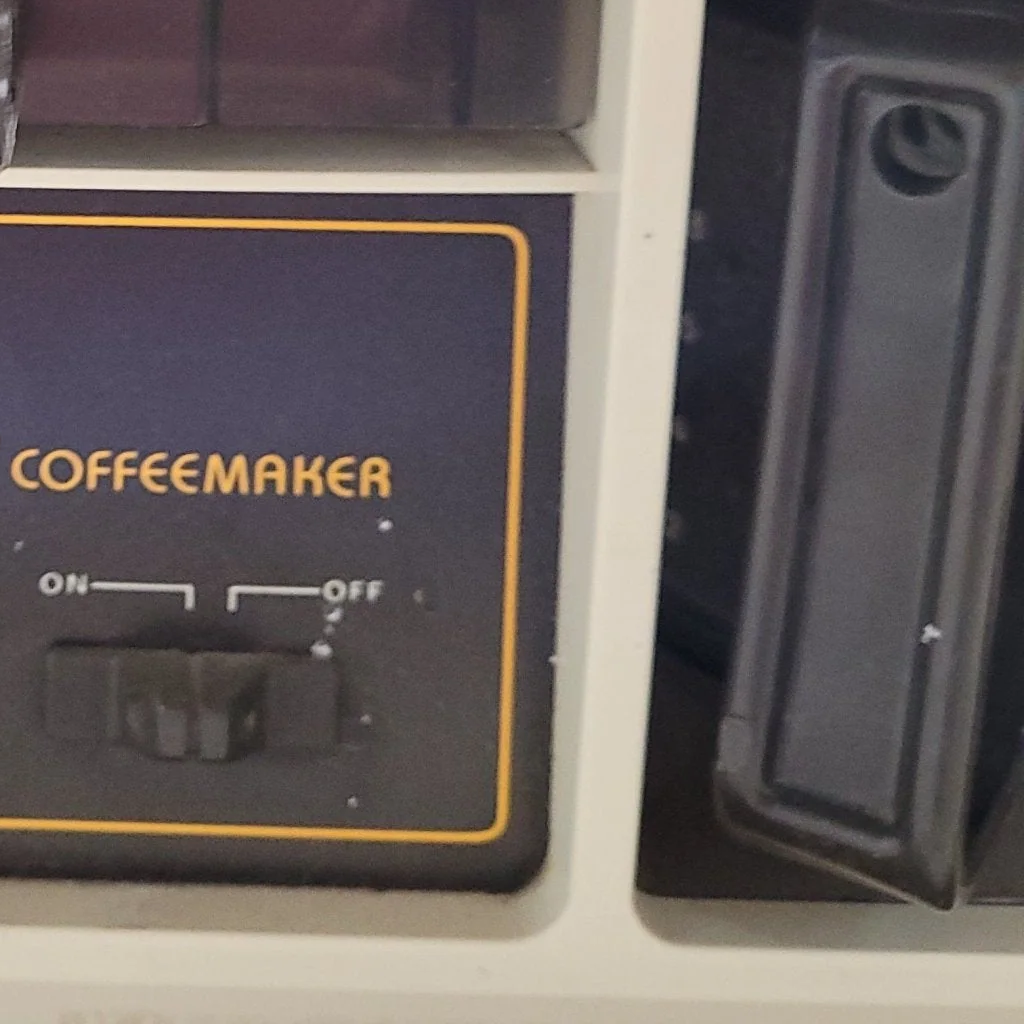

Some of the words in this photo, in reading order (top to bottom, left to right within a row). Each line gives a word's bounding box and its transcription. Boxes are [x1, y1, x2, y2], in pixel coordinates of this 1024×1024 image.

[9, 447, 393, 499] COFFEEMAKER
[38, 571, 90, 597] ON
[320, 578, 385, 605] OFF
